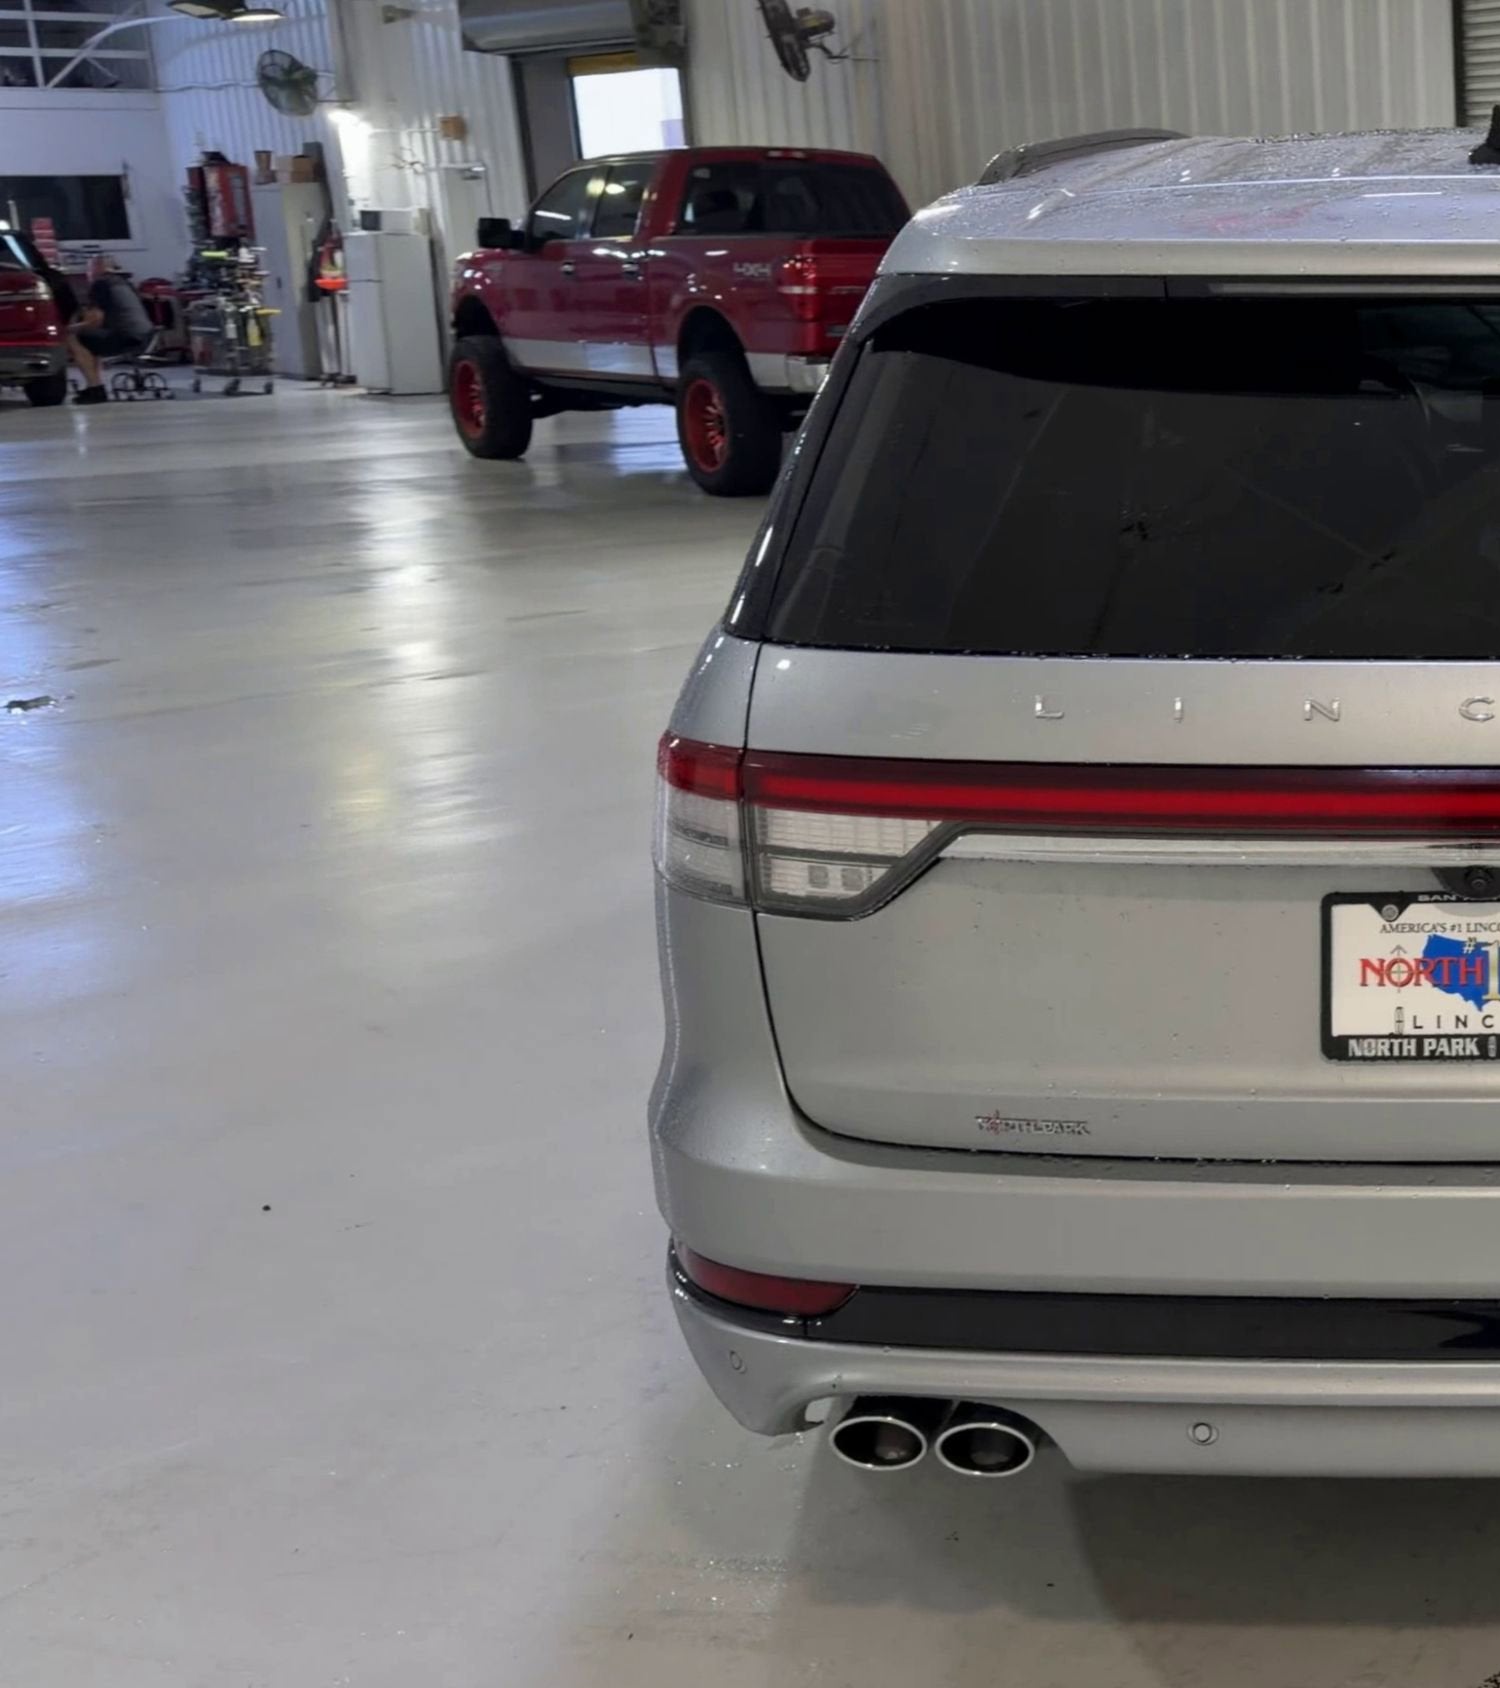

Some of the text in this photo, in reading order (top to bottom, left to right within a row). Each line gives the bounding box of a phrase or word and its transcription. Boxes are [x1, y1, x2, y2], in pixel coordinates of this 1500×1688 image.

[1417, 893, 1457, 902] SAN
[1379, 922, 1447, 934] AMERICA'S
[1449, 922, 1463, 933] #1
[1360, 957, 1484, 987] NORTH
[1348, 1038, 1416, 1057] NORTH
[1423, 1037, 1480, 1057] PARK
